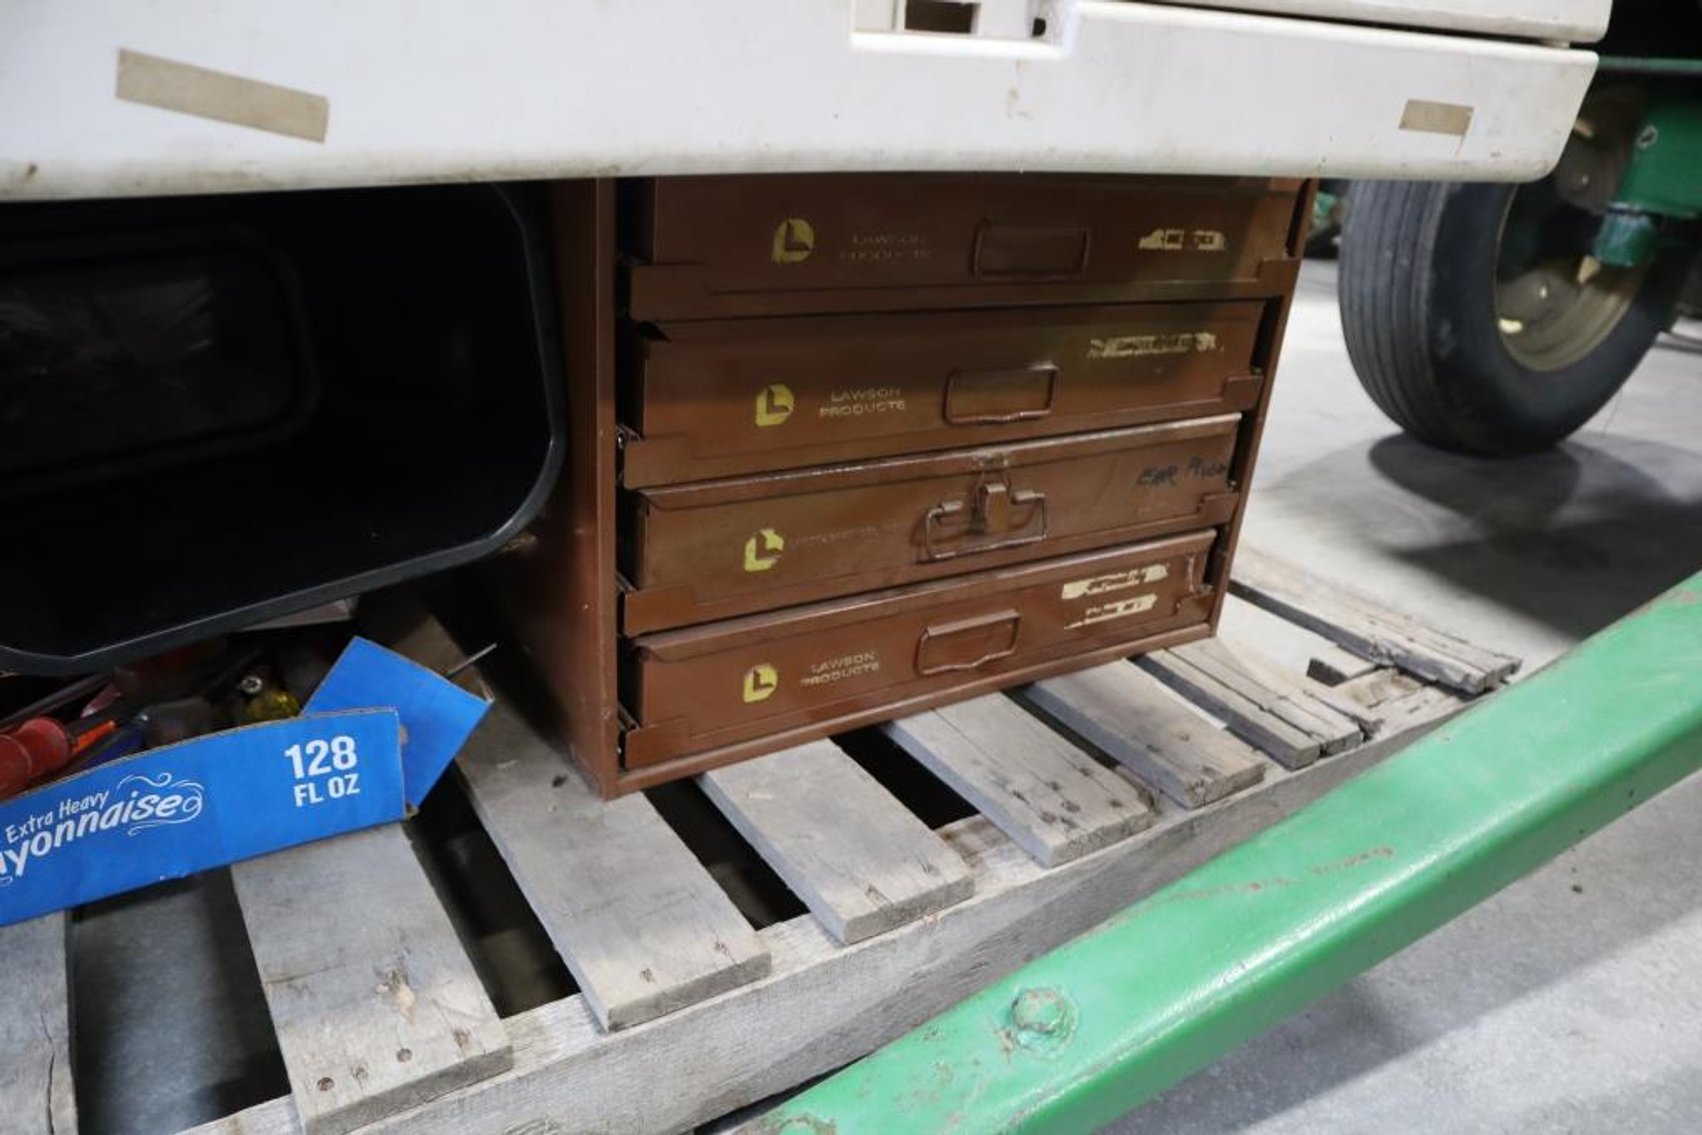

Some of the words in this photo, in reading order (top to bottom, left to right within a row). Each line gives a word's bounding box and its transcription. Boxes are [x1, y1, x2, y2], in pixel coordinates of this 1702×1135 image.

[830, 387, 902, 402] LAWSON
[819, 400, 906, 417] PRODUCTS
[800, 661, 880, 687] PRODUCTS
[811, 651, 876, 673] LAWSON
[284, 735, 358, 780] 128
[293, 782, 325, 808] FL
[327, 773, 361, 799] OZ
[5, 811, 54, 844] Extra
[58, 790, 110, 819] Heavy
